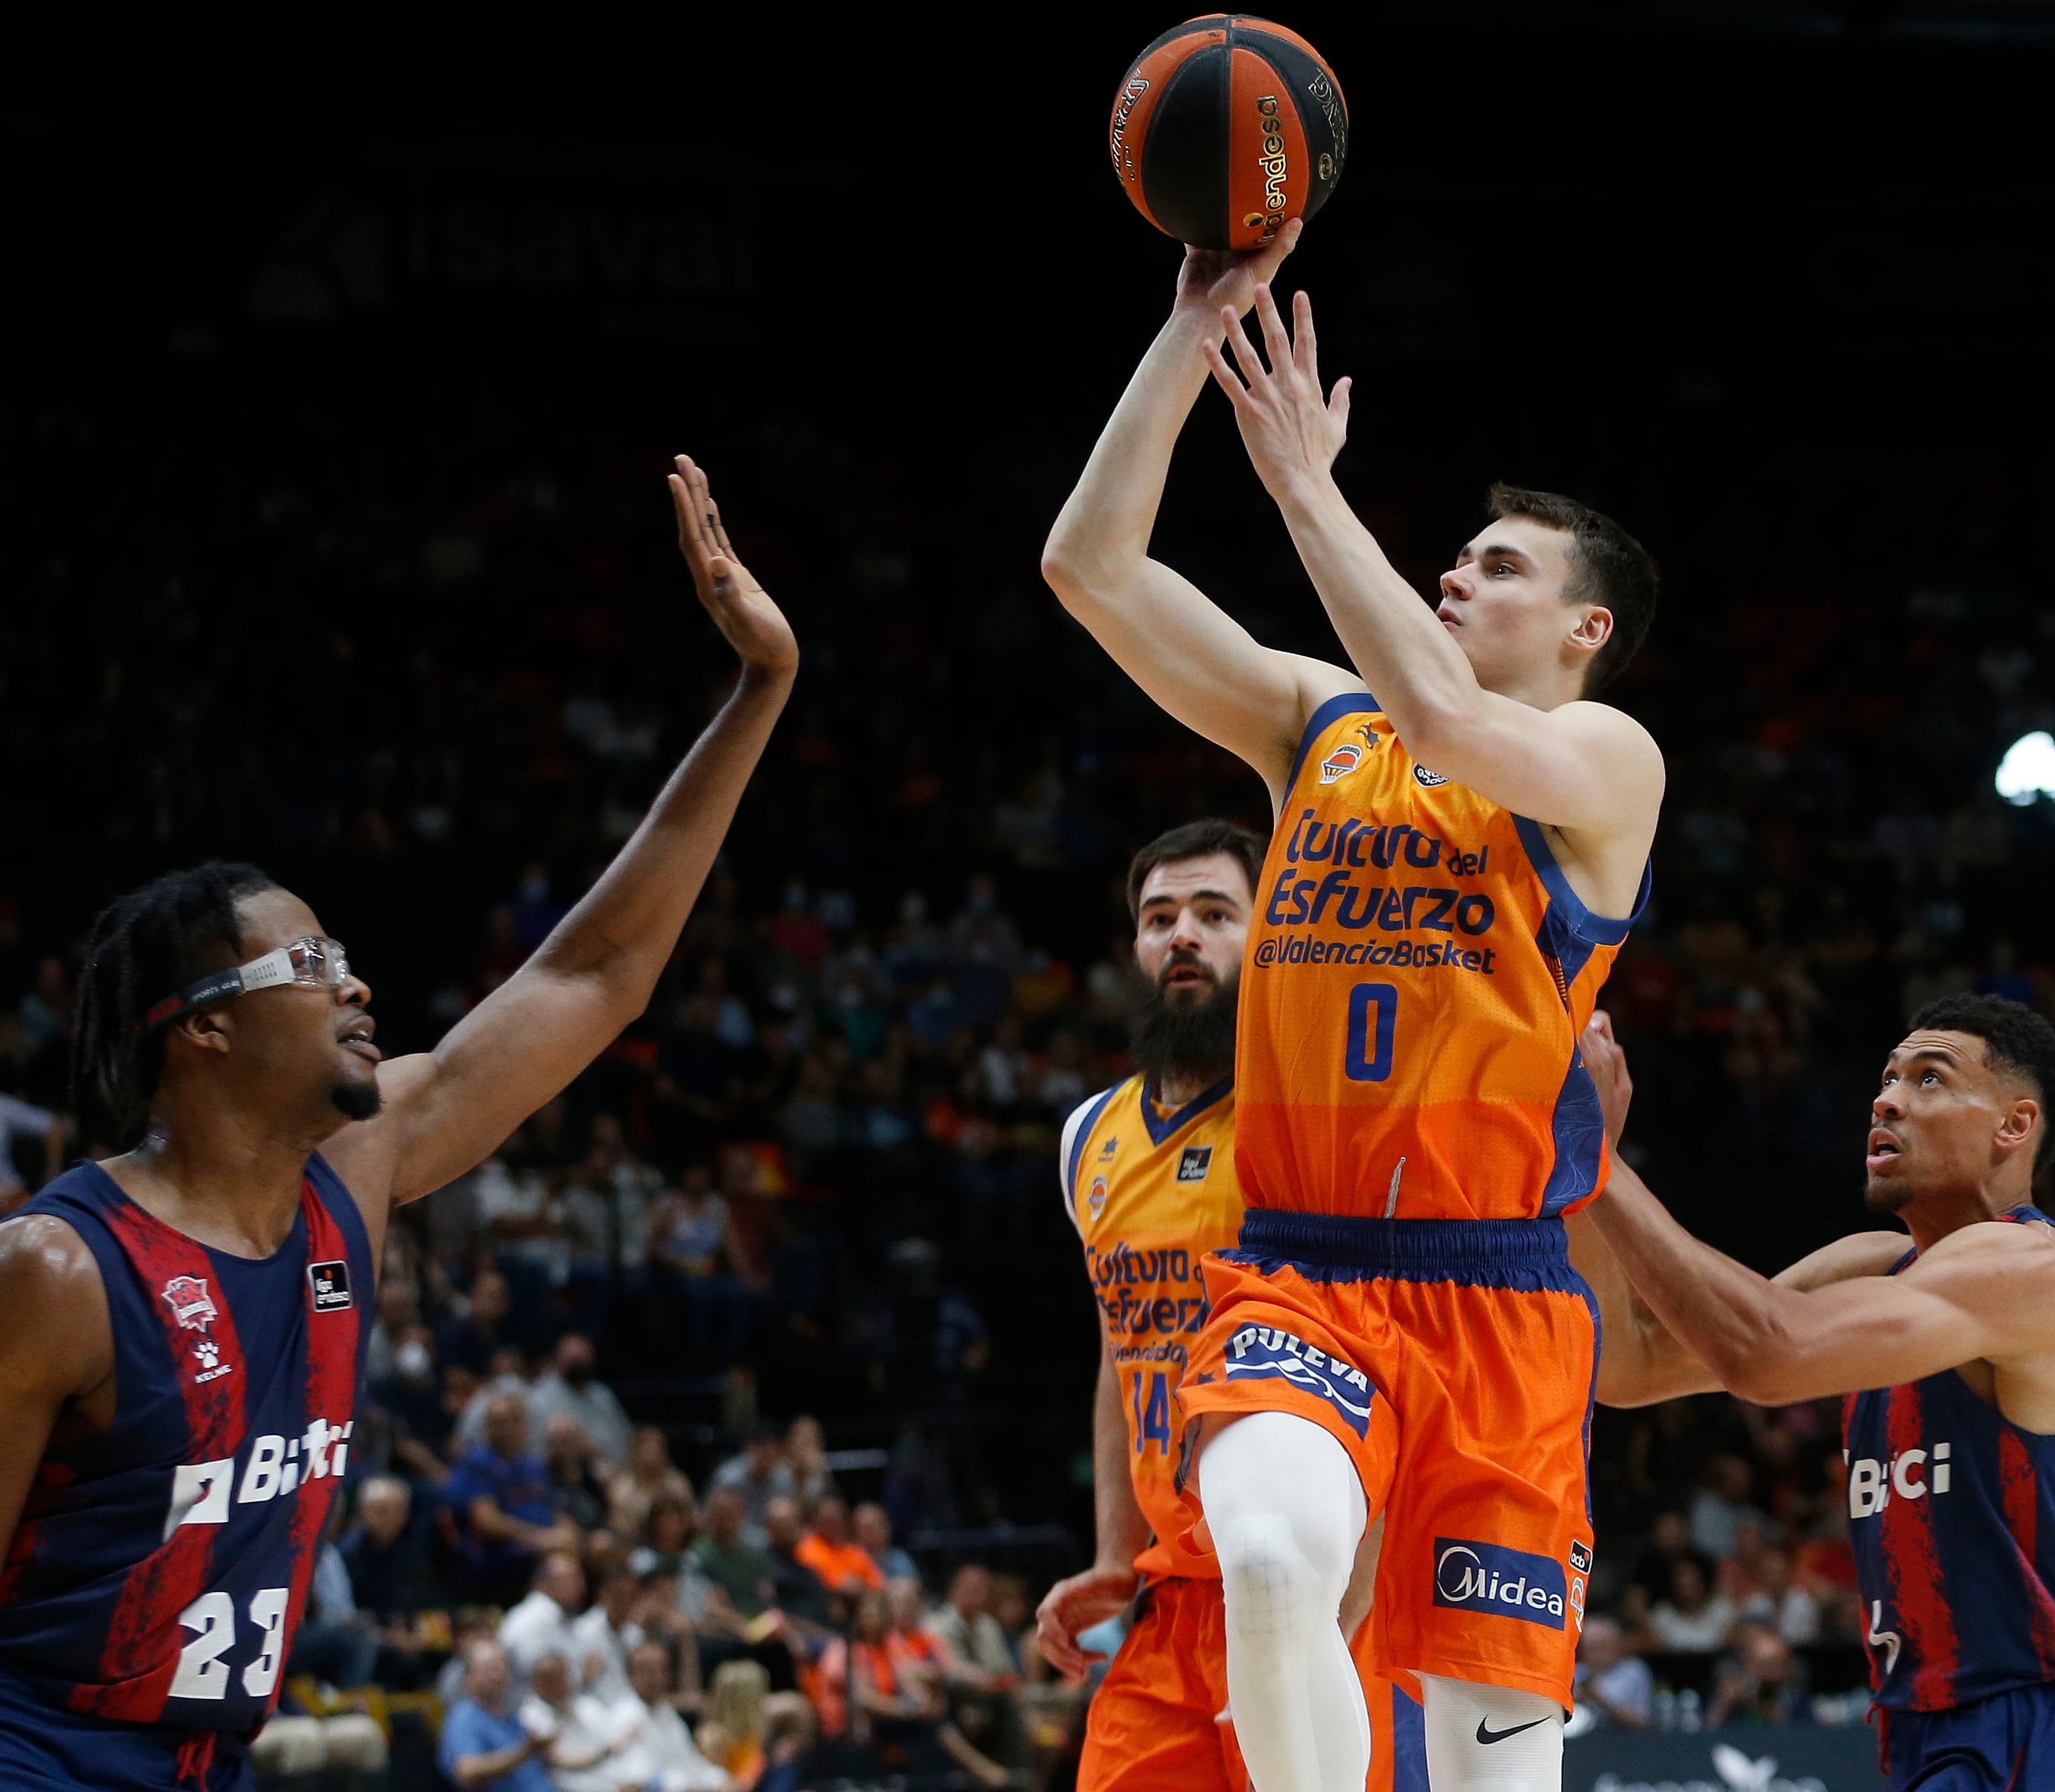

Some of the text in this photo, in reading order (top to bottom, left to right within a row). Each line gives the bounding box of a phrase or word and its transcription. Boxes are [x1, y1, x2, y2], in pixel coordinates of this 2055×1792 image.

[1256, 94, 1287, 211] endesa
[1446, 845, 1488, 878] del
[1266, 868, 1495, 935] Esfuerzo
[1254, 934, 1496, 975] @ValenciaBasket
[1345, 983, 1397, 1083] 0
[1233, 1328, 1368, 1393] PULEVA
[1133, 1371, 1171, 1456] 14
[1437, 1546, 1564, 1617] Midea
[1571, 1553, 1585, 1568] acb
[168, 1587, 289, 1700] 23
